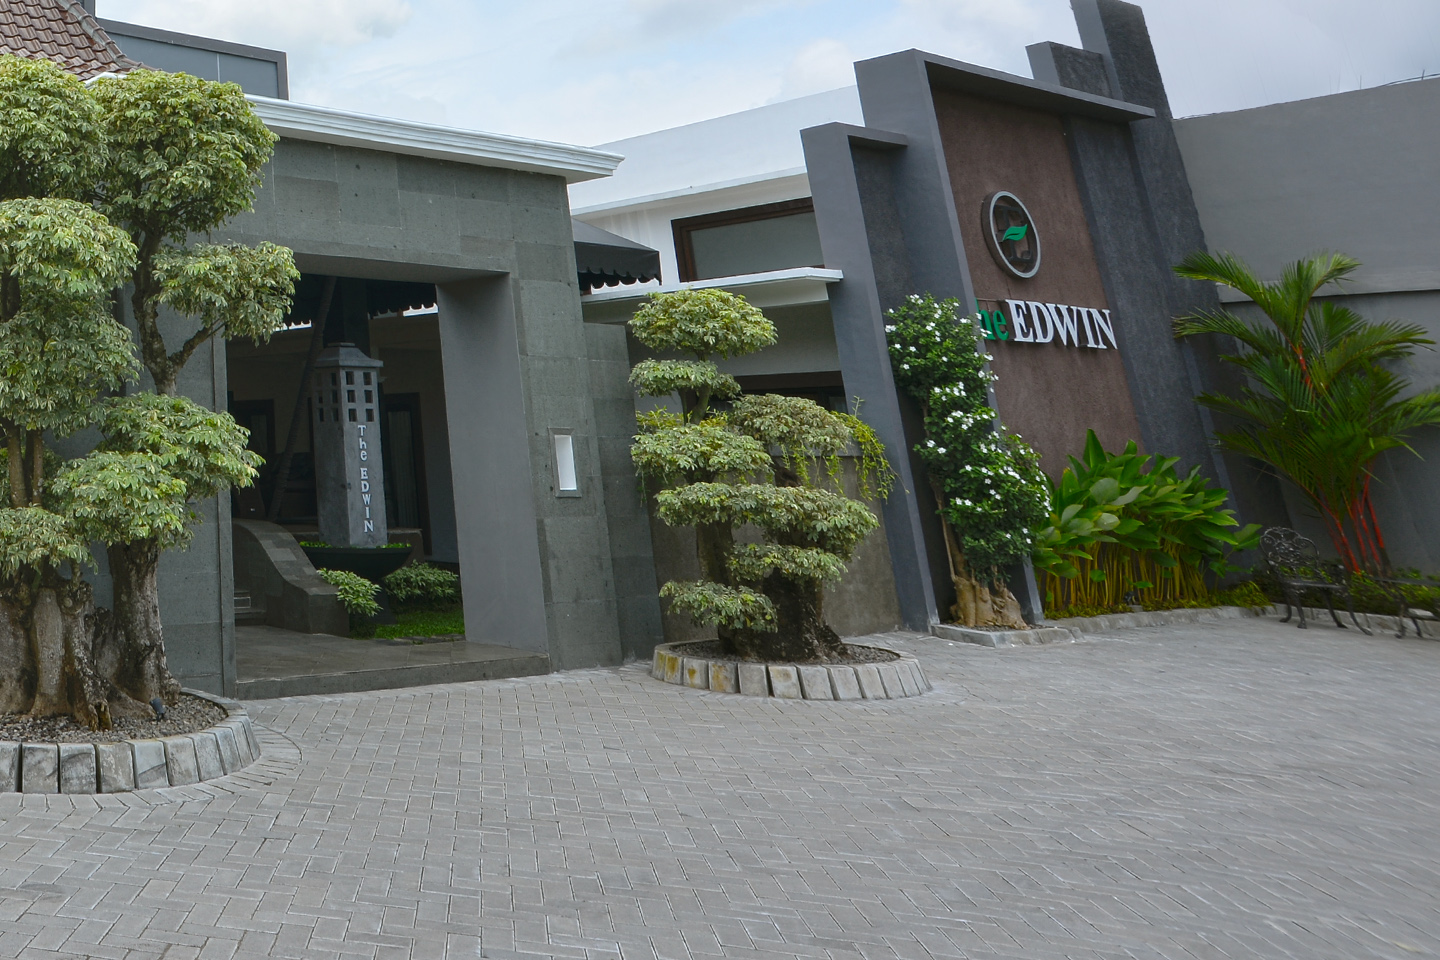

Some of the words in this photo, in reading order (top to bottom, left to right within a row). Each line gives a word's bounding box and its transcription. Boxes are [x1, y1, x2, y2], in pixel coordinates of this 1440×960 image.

[1005, 299, 1118, 350] EDWIN
[358, 425, 368, 461] The
[360, 468, 374, 533] EDWIN
